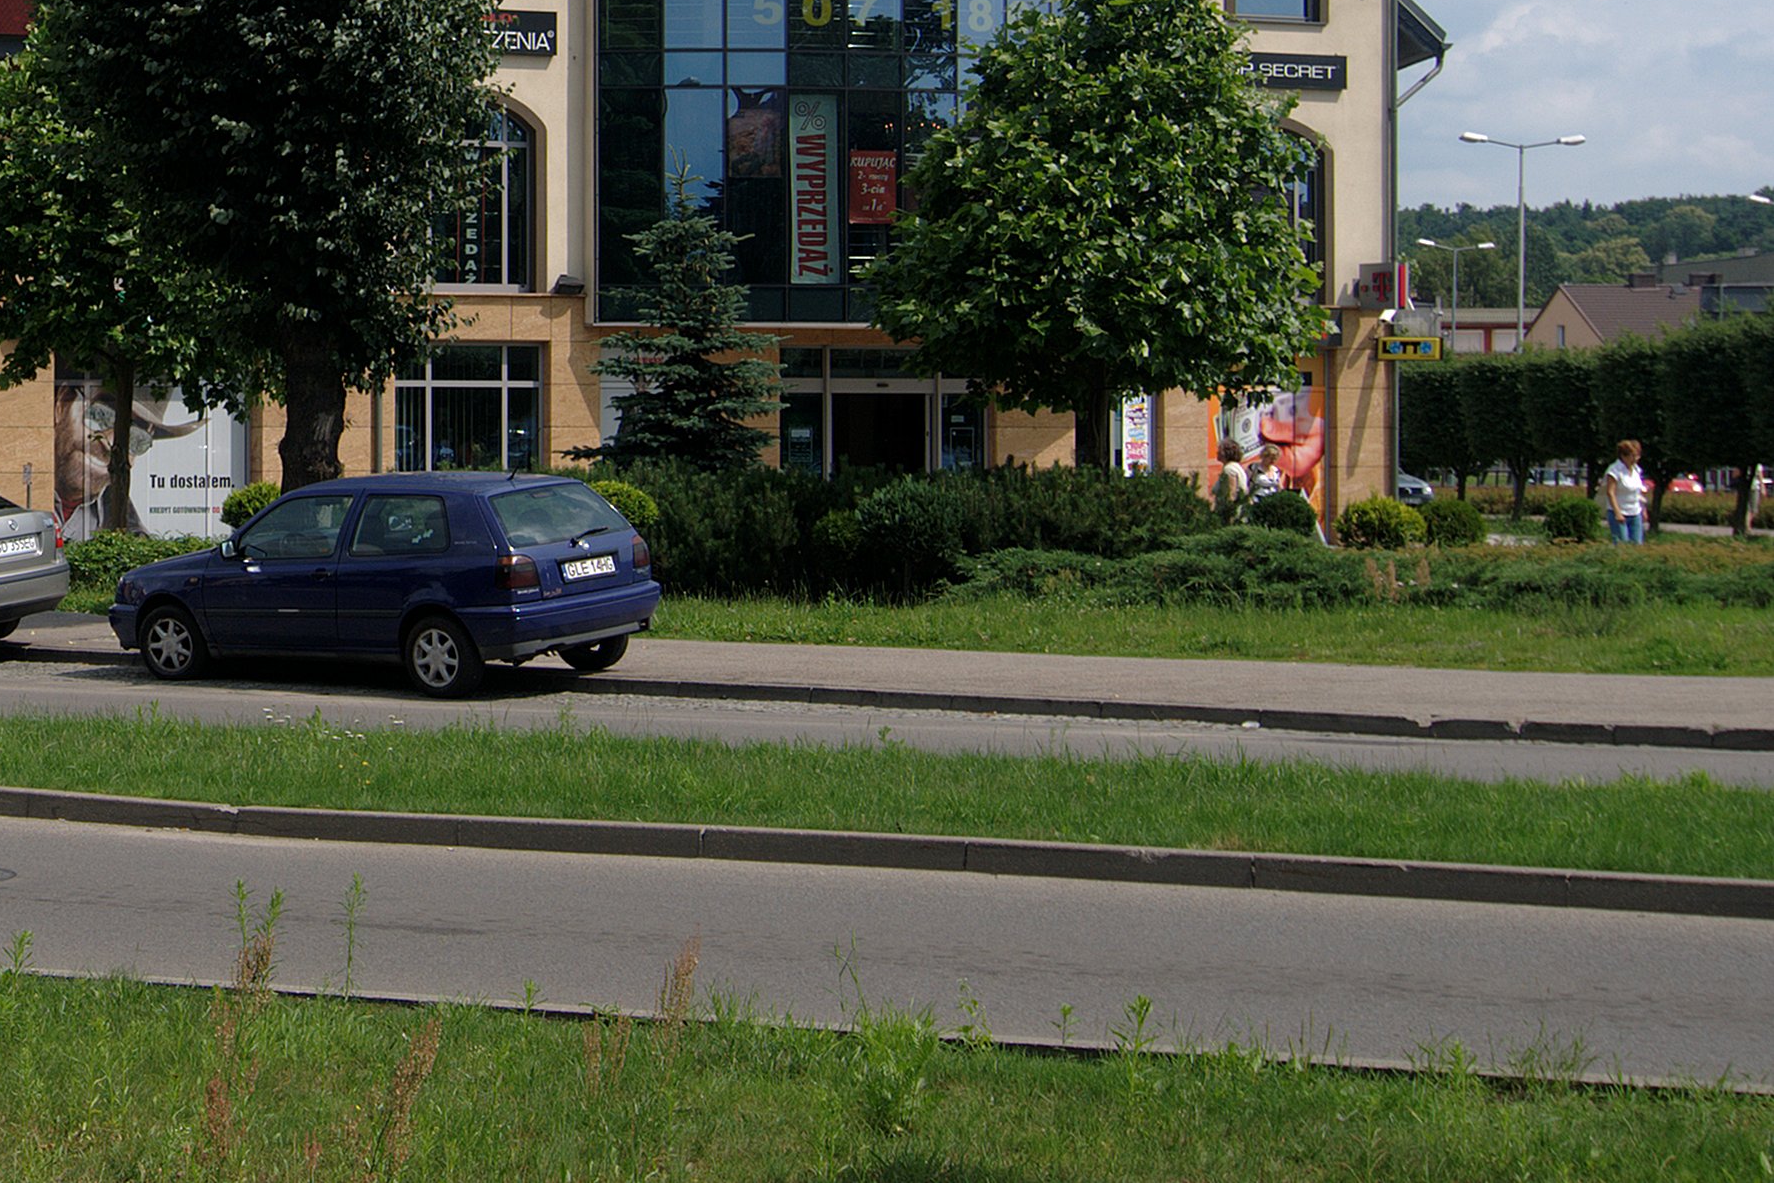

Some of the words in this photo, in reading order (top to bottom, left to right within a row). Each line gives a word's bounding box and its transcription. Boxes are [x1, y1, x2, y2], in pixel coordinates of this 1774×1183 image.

[1259, 62, 1337, 79] SECRET
[795, 133, 834, 278] WYPRZEDAŻ
[1382, 340, 1433, 355] LOTTO
[149, 474, 165, 489] Tu
[567, 561, 589, 577] GLE
